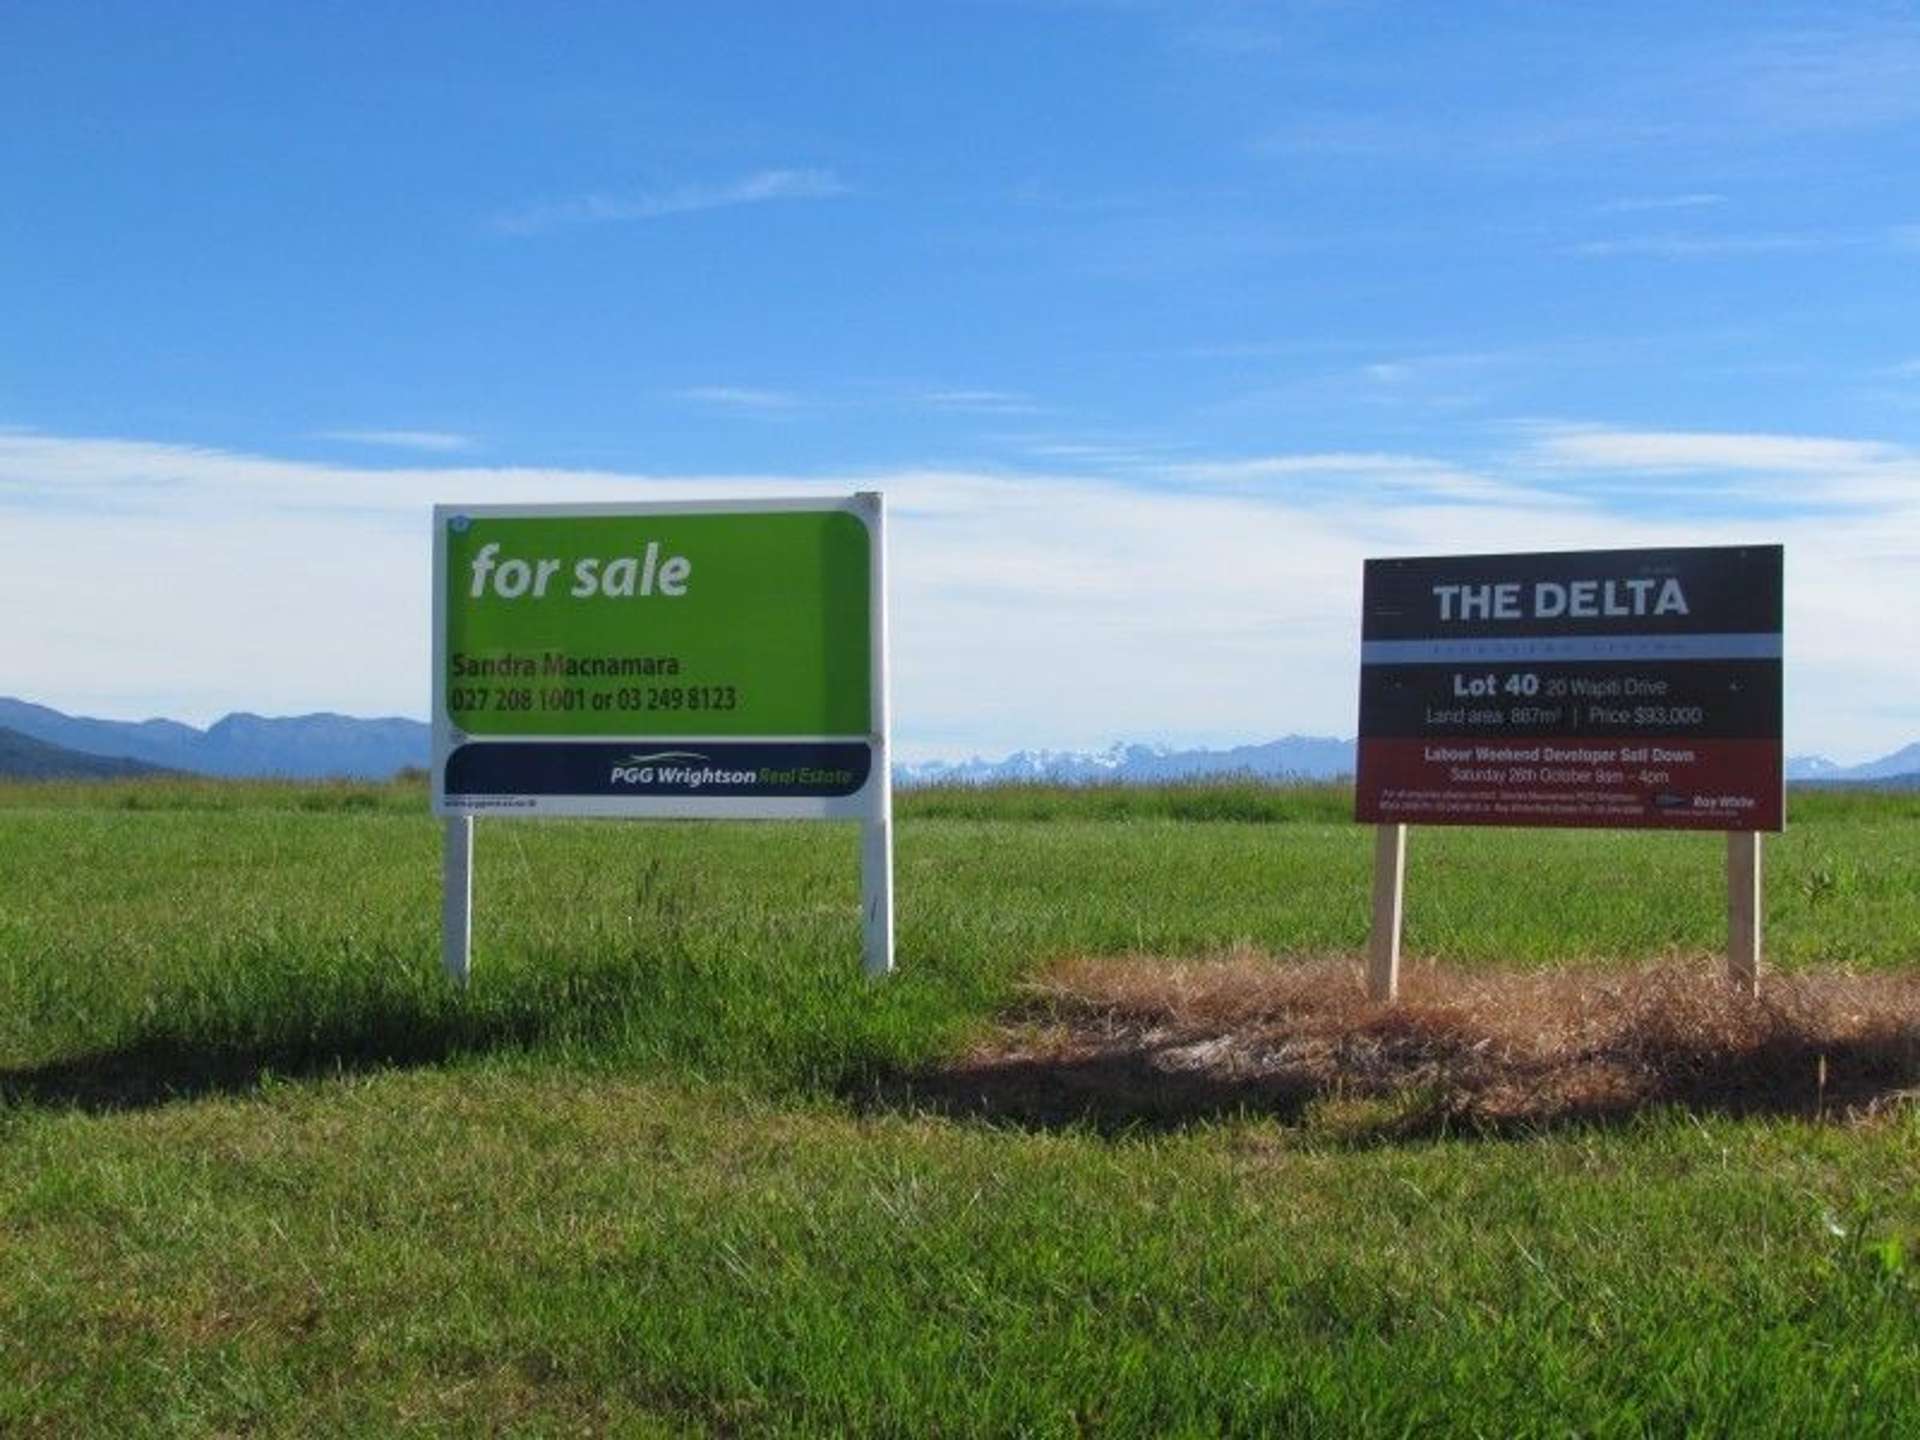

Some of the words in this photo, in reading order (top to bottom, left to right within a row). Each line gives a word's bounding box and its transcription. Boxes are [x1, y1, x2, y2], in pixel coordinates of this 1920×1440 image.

[470, 542, 559, 599] for
[571, 542, 691, 598] sale
[1433, 584, 1521, 620] THE
[1535, 578, 1689, 616] DELTA
[453, 652, 535, 677] Sandra
[544, 652, 680, 677] Macnamara
[1454, 674, 1496, 696] Lot
[1505, 673, 1539, 695] 40
[1545, 679, 1567, 695] 20
[1624, 677, 1668, 695] Drive
[452, 688, 488, 711] 027
[496, 688, 532, 711] 208
[539, 688, 584, 711] 1001
[592, 693, 612, 711] or
[617, 688, 640, 710] 03
[647, 688, 684, 710] 249
[685, 686, 736, 710] 8123
[1425, 706, 1464, 723] Land
[1589, 706, 1631, 723] Price
[1424, 747, 1472, 761] Labour
[1476, 747, 1539, 762] Weekend
[1544, 747, 1616, 765] Developer
[1652, 748, 1694, 762] Down
[611, 767, 653, 784] PGG
[658, 766, 756, 787] Wrightson
[759, 767, 794, 784] Real
[799, 767, 852, 785] Estate
[1450, 768, 1504, 785] Saturday
[1540, 768, 1592, 783] October
[1638, 769, 1670, 785] 4pm
